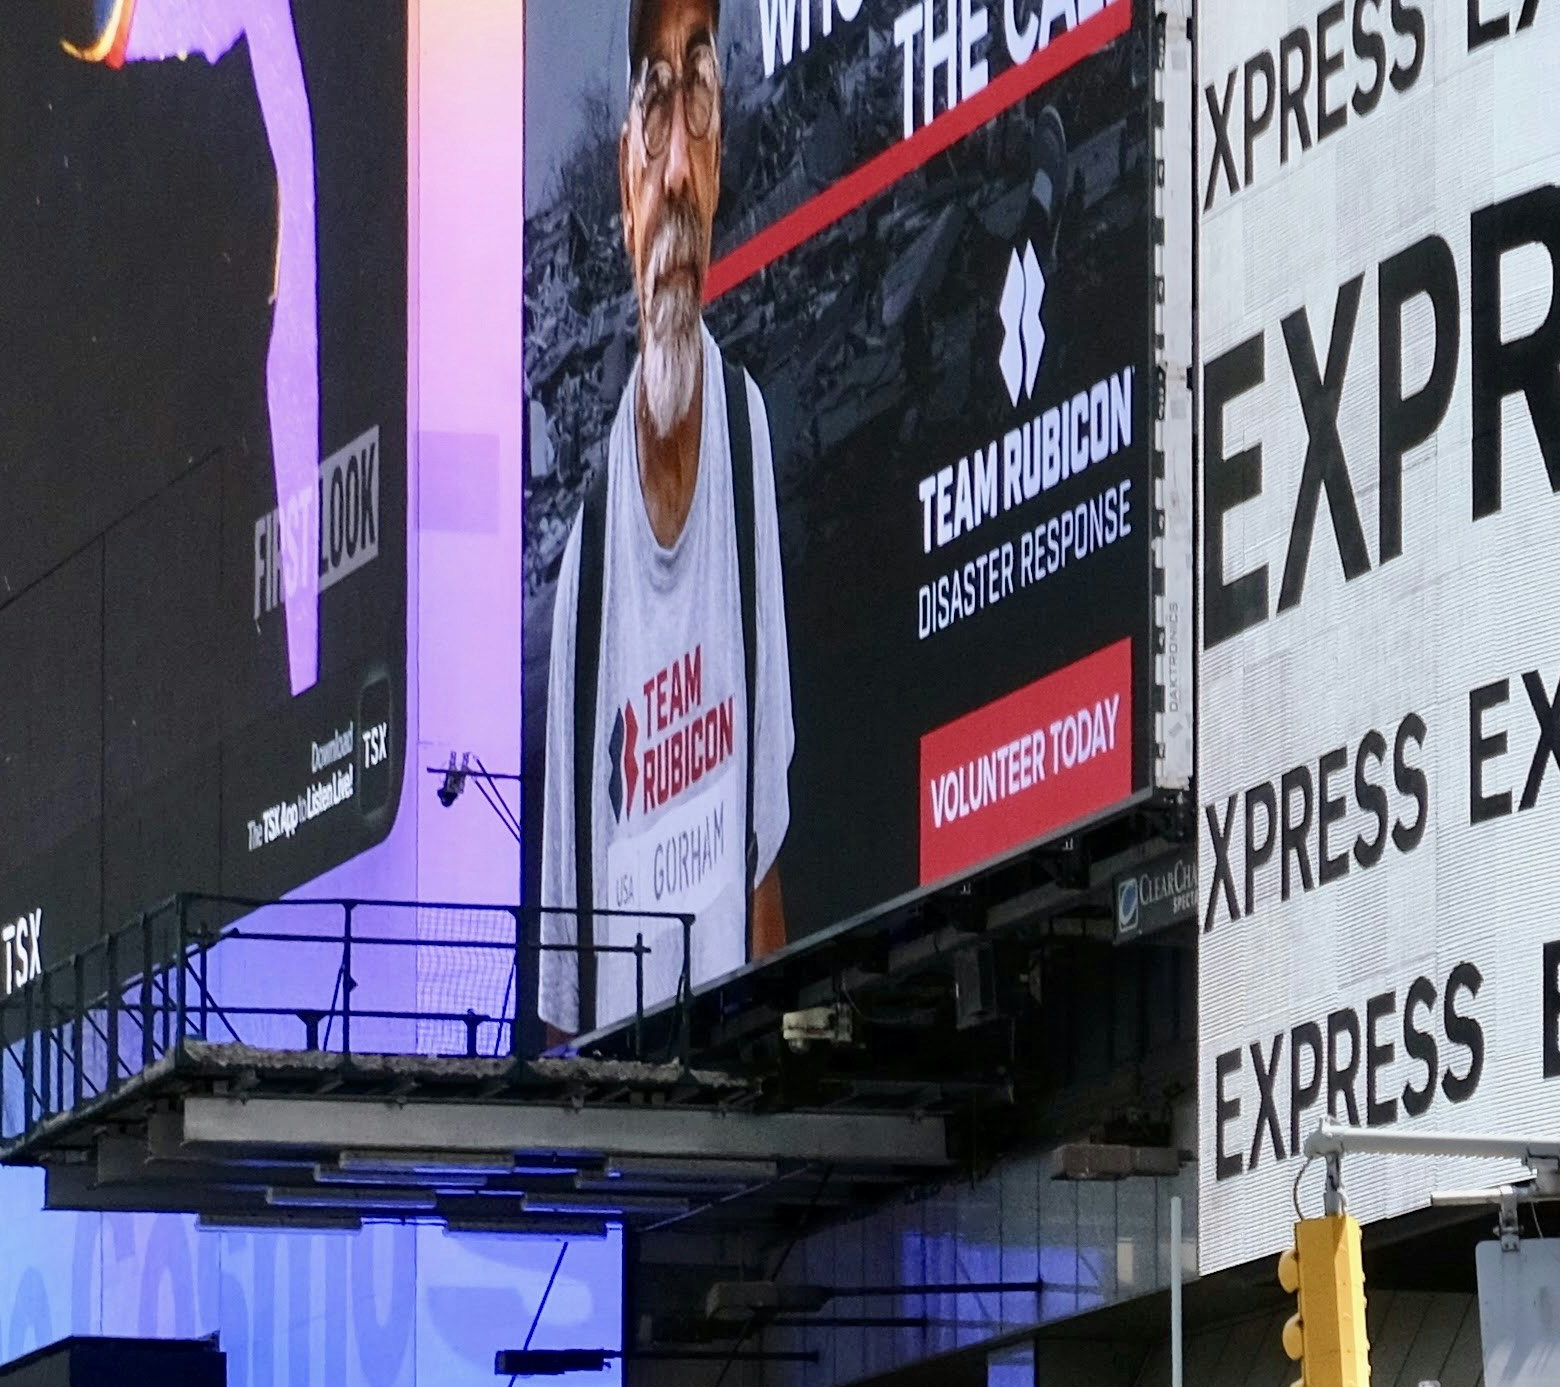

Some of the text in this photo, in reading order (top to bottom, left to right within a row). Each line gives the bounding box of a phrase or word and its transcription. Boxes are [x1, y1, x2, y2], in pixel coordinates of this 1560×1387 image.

[894, 0, 989, 139] THE
[316, 443, 376, 568] LOOK
[919, 367, 1132, 553] TEAM RUBICON
[918, 478, 1132, 640] DISASTER RESPONSE
[311, 721, 354, 774] Download
[362, 722, 387, 768] TSX
[643, 643, 701, 740] TEAM
[280, 801, 299, 839] App
[307, 781, 333, 820] Listen
[643, 695, 733, 816] RUBICON
[932, 694, 1120, 829] VOLUNTEER TODAY
[654, 800, 725, 902] GORHAM
[1204, 711, 1430, 933] XPRESS
[2, 908, 43, 995] TSX
[616, 874, 635, 908] USA
[1216, 960, 1486, 1184] EXPRESS
